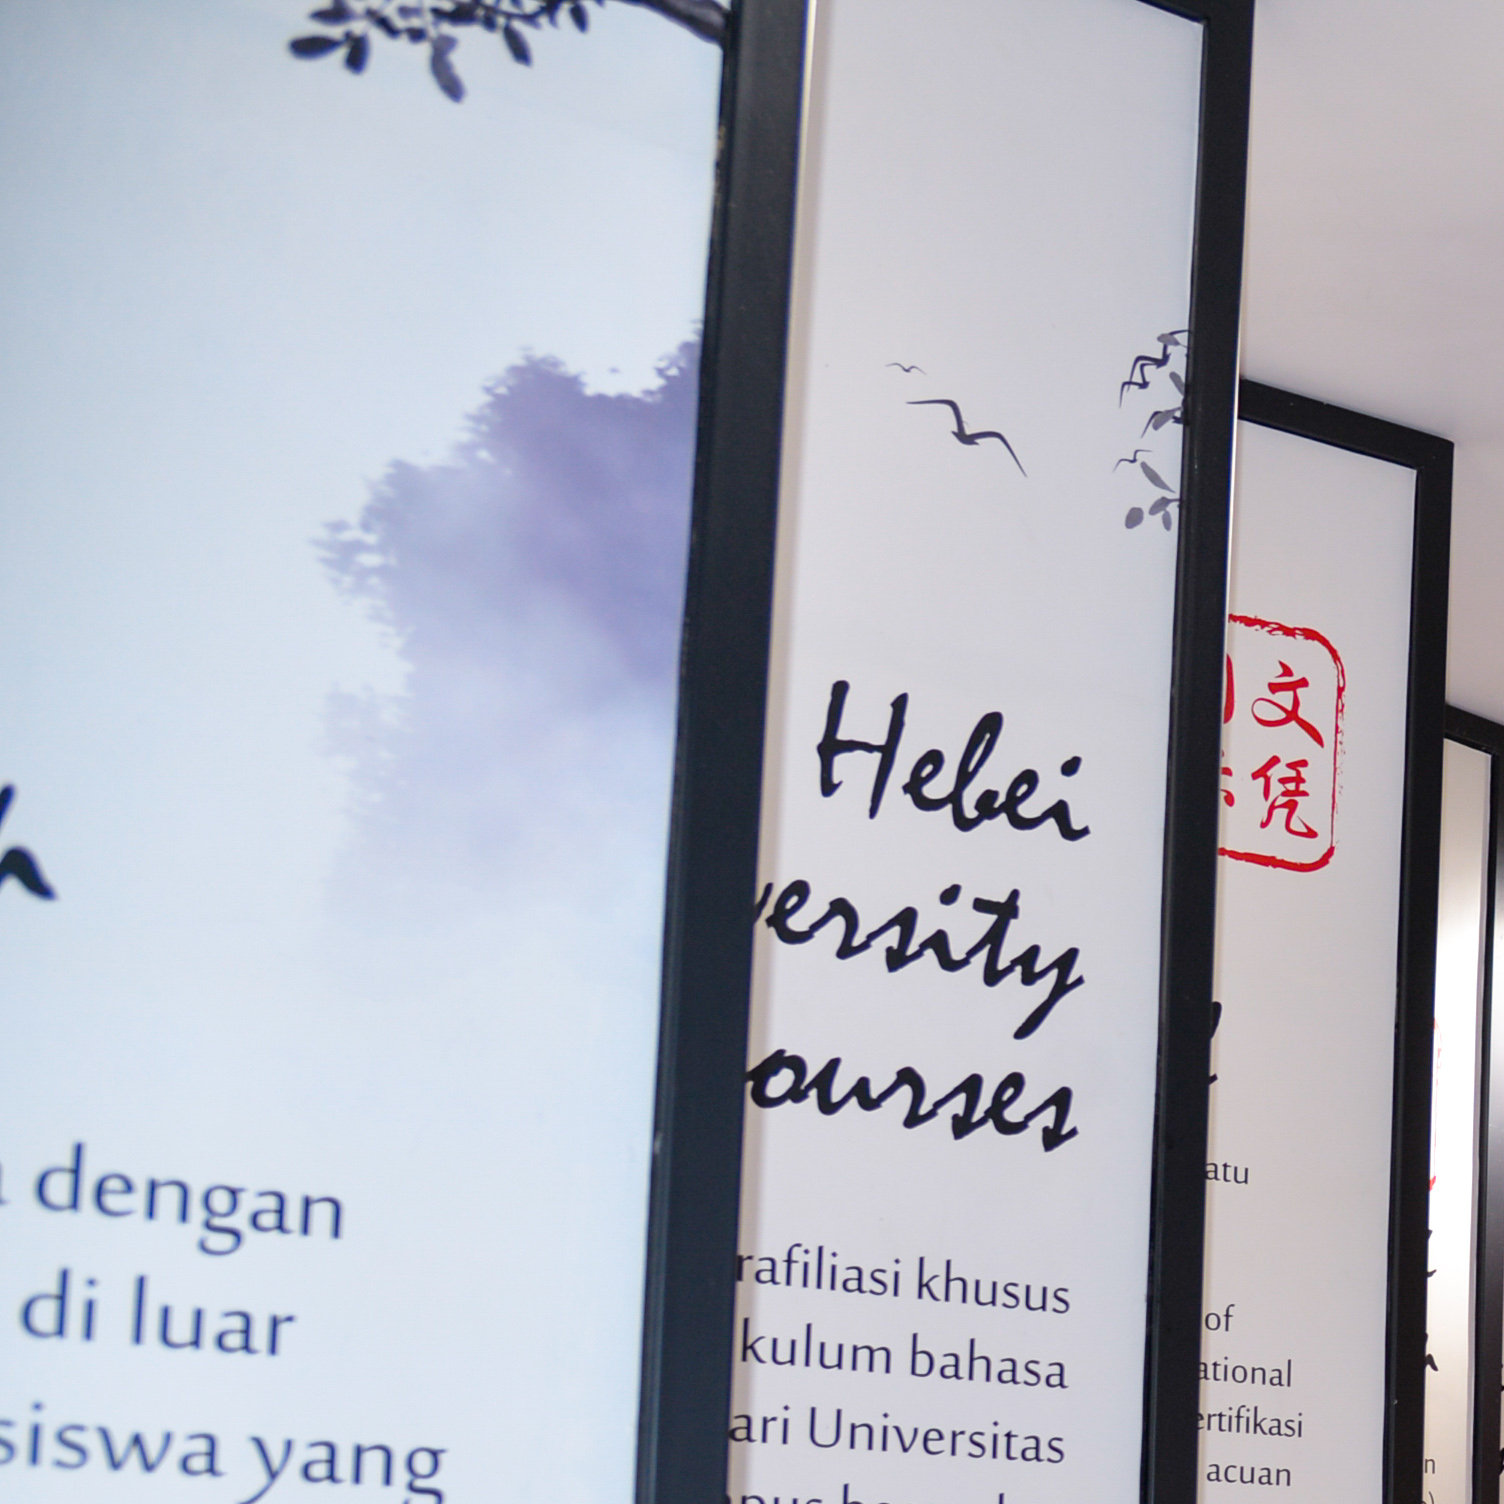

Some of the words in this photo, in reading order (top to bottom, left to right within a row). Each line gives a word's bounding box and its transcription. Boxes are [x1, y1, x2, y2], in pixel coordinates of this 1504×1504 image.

[816, 679, 1091, 842] Hebei
[752, 879, 1086, 1040] ersity
[748, 1048, 1078, 1153] ourses
[35, 1141, 344, 1256] dengan
[20, 1267, 99, 1342] di
[132, 1274, 297, 1357] luar
[736, 1243, 902, 1299] rafiliasi
[916, 1257, 1071, 1315] khusus
[1204, 1303, 1235, 1333] of
[740, 1318, 893, 1376] kulum
[909, 1333, 1069, 1390] bahasa
[728, 1404, 791, 1445] ari
[808, 1406, 1066, 1465] Universitas
[1205, 1460, 1292, 1487] acuan
